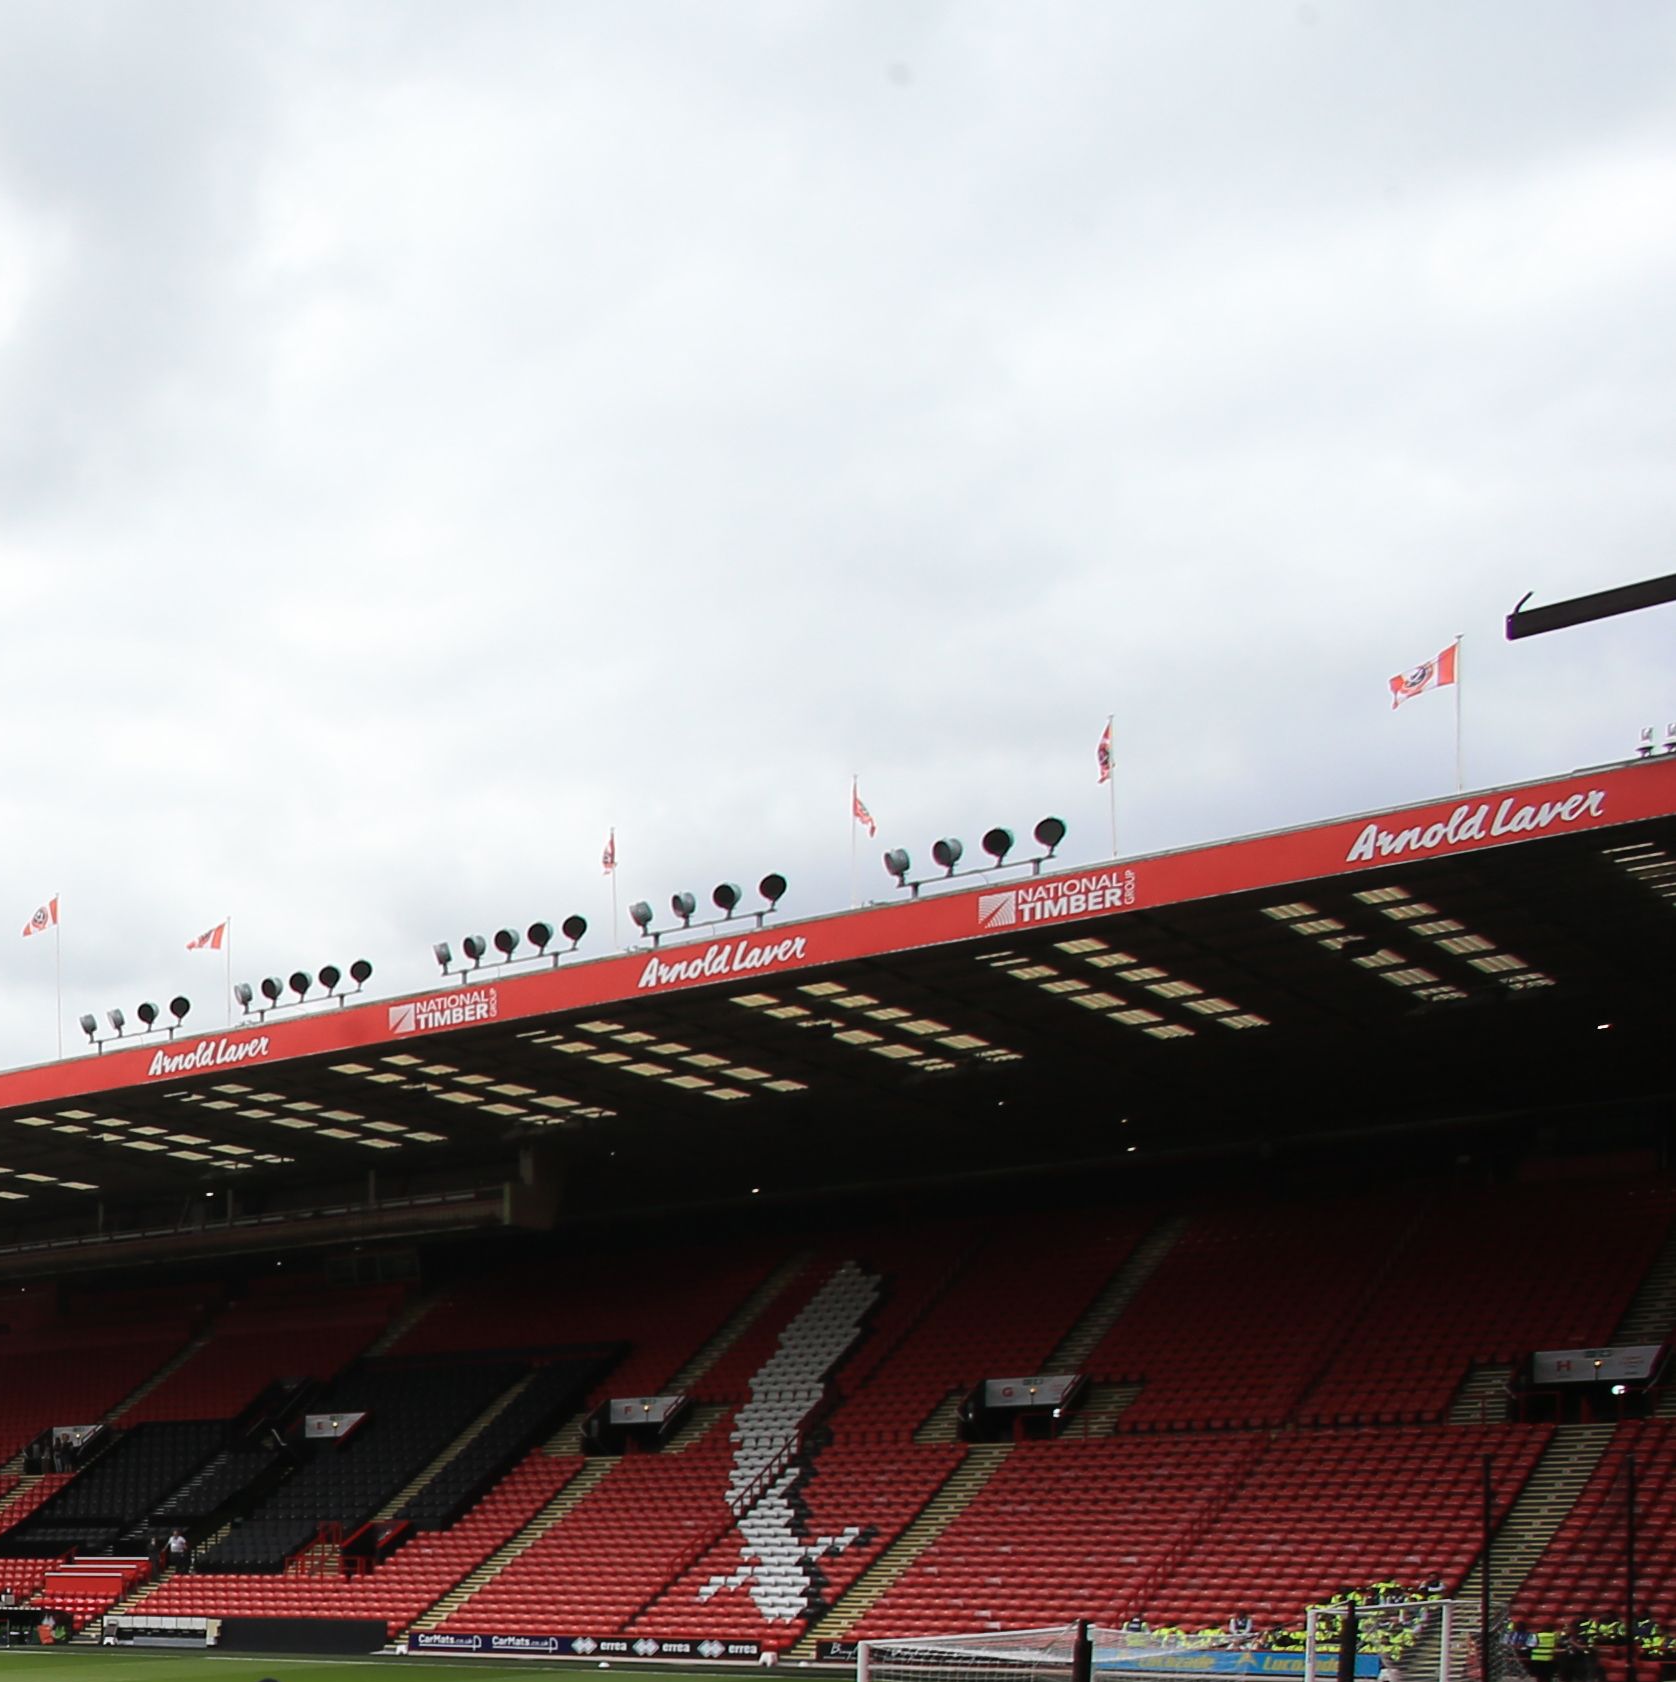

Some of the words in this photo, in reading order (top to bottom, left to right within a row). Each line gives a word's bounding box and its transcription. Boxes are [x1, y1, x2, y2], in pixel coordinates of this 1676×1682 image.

[1345, 804, 1490, 862] Arnold
[1491, 790, 1605, 836] Laver
[1018, 871, 1124, 903] NATIONAL
[1124, 869, 1135, 906] GROUP
[1018, 888, 1122, 922] TIMBER
[638, 944, 730, 988] Arnold
[732, 936, 808, 971] Laver
[415, 992, 489, 1015] NATIONAL
[417, 1003, 490, 1029] TIMBER
[148, 1041, 215, 1076] Arnold
[215, 1036, 270, 1065] Laver
[600, 1641, 627, 1652] errea
[662, 1642, 690, 1653] errea
[728, 1643, 757, 1655] errea
